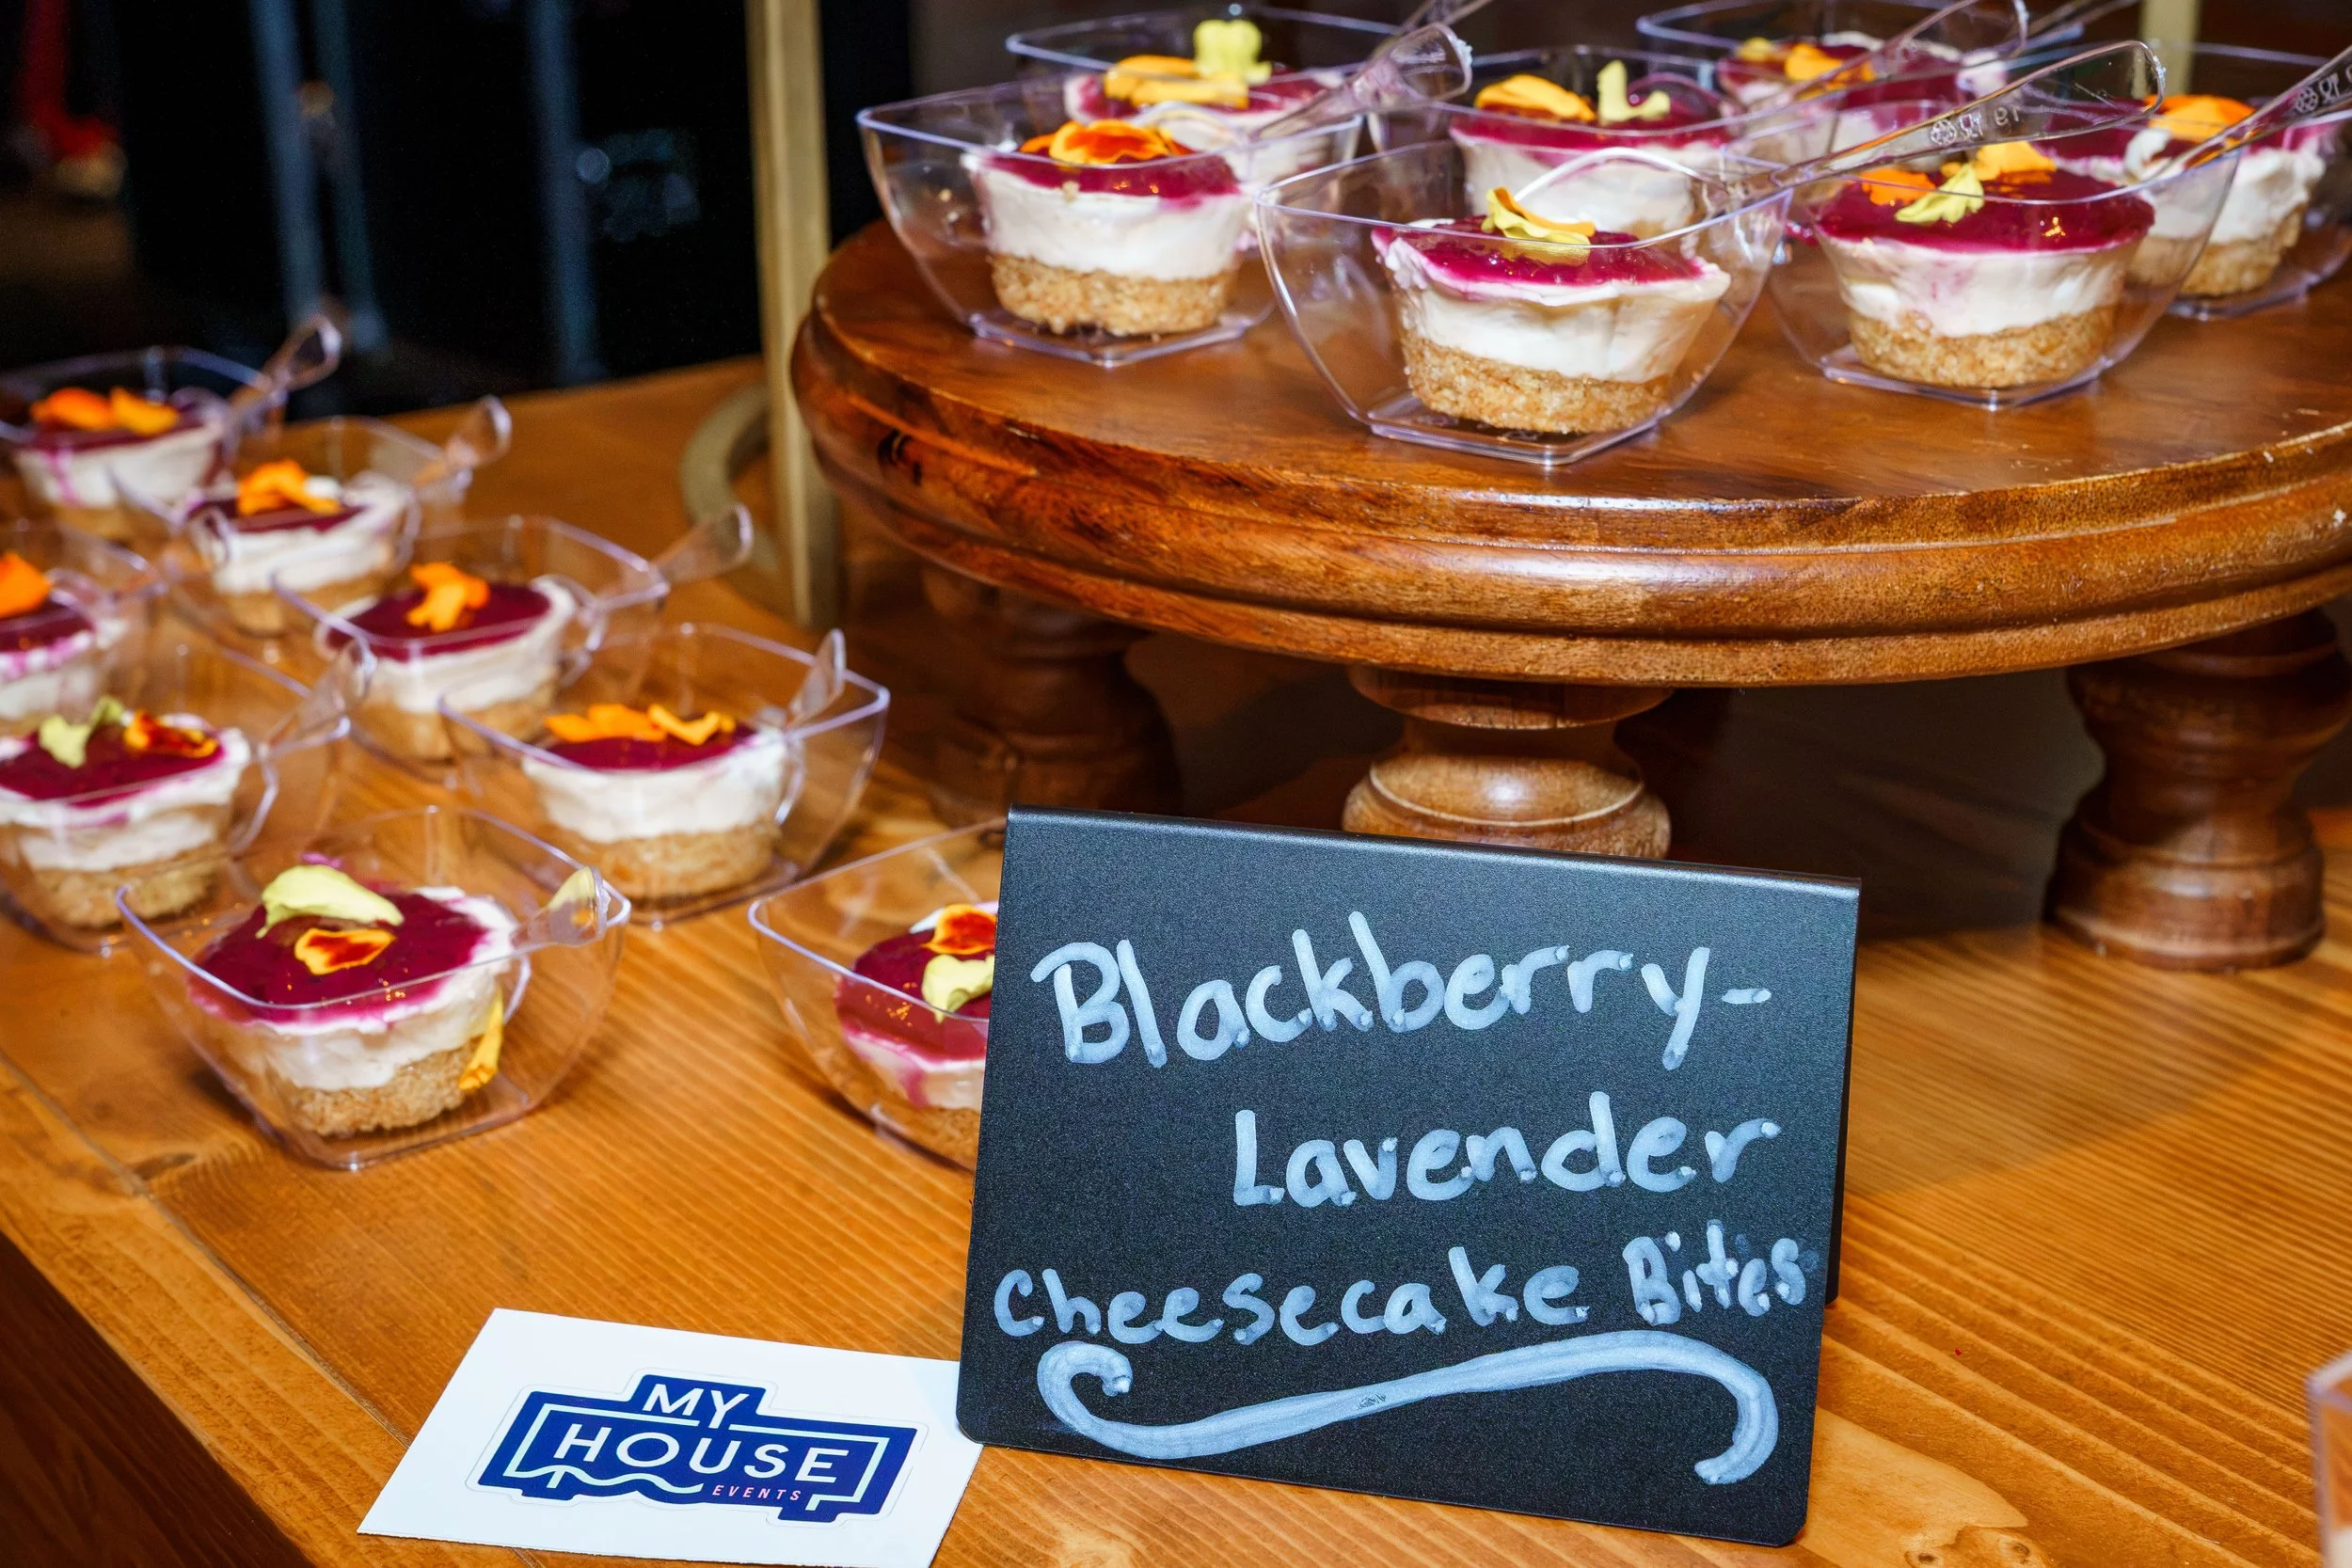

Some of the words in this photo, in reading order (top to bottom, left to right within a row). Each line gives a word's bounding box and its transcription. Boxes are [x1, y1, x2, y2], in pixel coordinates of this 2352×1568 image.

[1029, 911, 1772, 1069] Blackberry-
[1233, 1091, 1782, 1208] Lavender
[1623, 1222, 1806, 1326] Bites
[642, 1383, 751, 1429] MY
[552, 1423, 850, 1483] HOUSE
[711, 1484, 802, 1501] EVENTS
